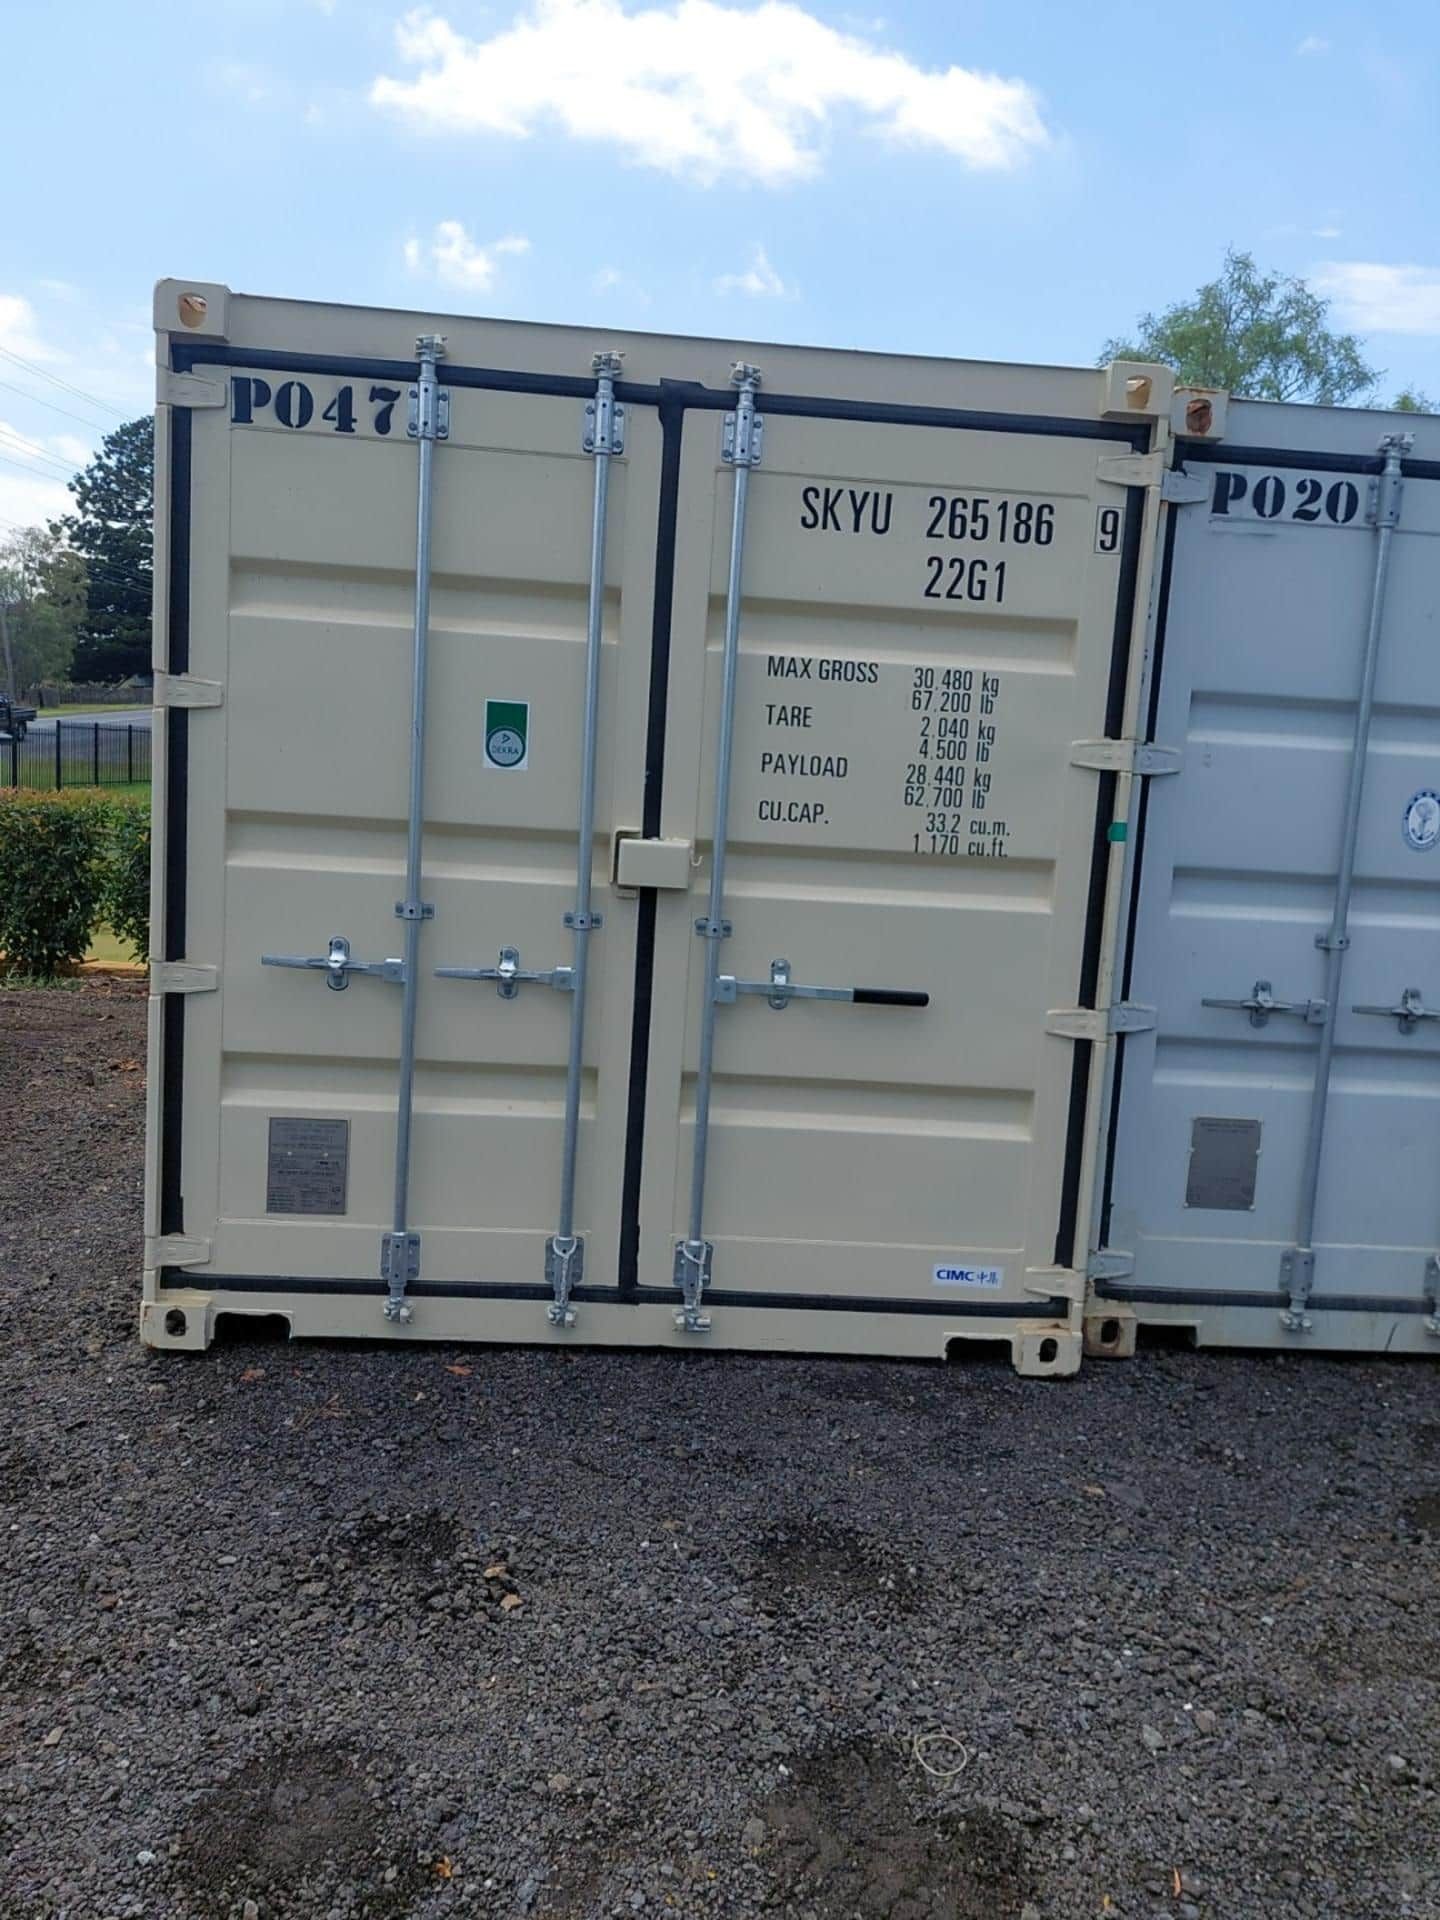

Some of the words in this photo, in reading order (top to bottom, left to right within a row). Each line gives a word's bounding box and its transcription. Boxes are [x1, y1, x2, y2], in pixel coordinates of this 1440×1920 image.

[801, 487, 893, 534] SKYU
[926, 496, 1055, 546] 265186
[1099, 509, 1120, 551] 9
[924, 556, 1006, 602] 22G1
[767, 655, 812, 679] MAX
[818, 659, 879, 683] GROSS
[913, 667, 973, 691] 30.480
[981, 671, 1000, 698] kg
[911, 690, 972, 713] 67.200
[980, 694, 994, 715] lb
[765, 704, 813, 728] TARE
[920, 716, 969, 739] 2.040
[977, 719, 996, 746] kg
[919, 738, 967, 761] 4.500
[975, 741, 990, 763] lb
[760, 752, 848, 778] PAYLOAD
[905, 763, 965, 787] 28.440
[973, 767, 991, 793] kg
[904, 785, 963, 809] 62.700
[971, 788, 985, 810] lb
[758, 800, 829, 825] CU.CAP.
[926, 812, 961, 834] 33.2
[969, 819, 1010, 837] cu.m.
[913, 832, 959, 856] 1.170
[967, 837, 1008, 858] cu.ft.
[936, 1268, 975, 1282] CIMC
